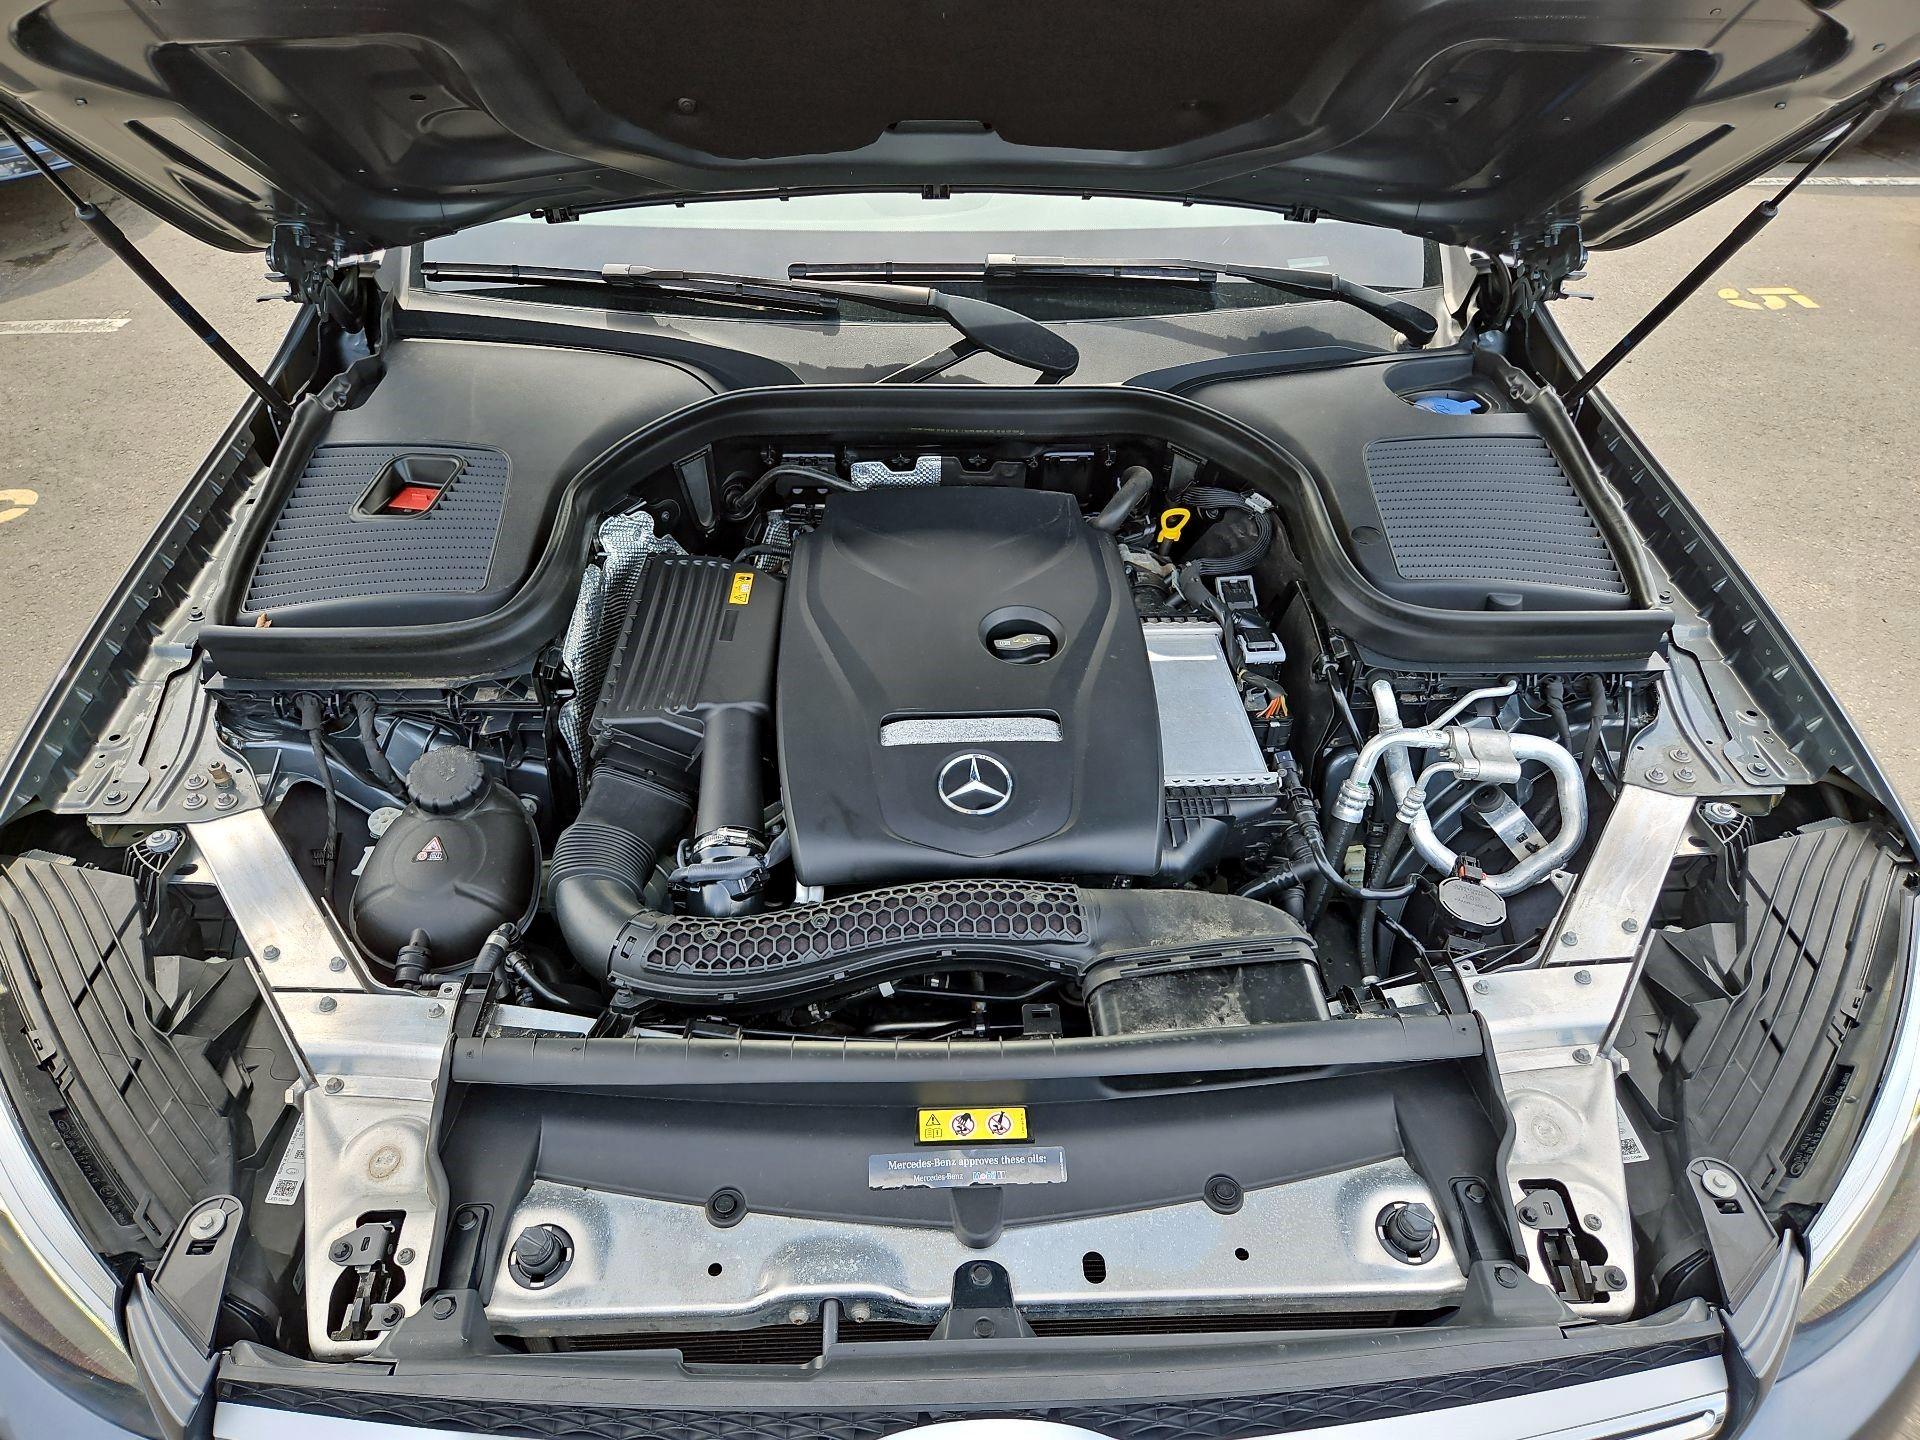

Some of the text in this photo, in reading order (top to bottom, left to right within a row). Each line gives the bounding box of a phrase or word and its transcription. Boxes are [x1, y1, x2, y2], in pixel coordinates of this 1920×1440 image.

[887, 1153, 1047, 1170] Mercedes-Benz approves these oils:
[913, 1172, 964, 1183] Mercedes-Benz
